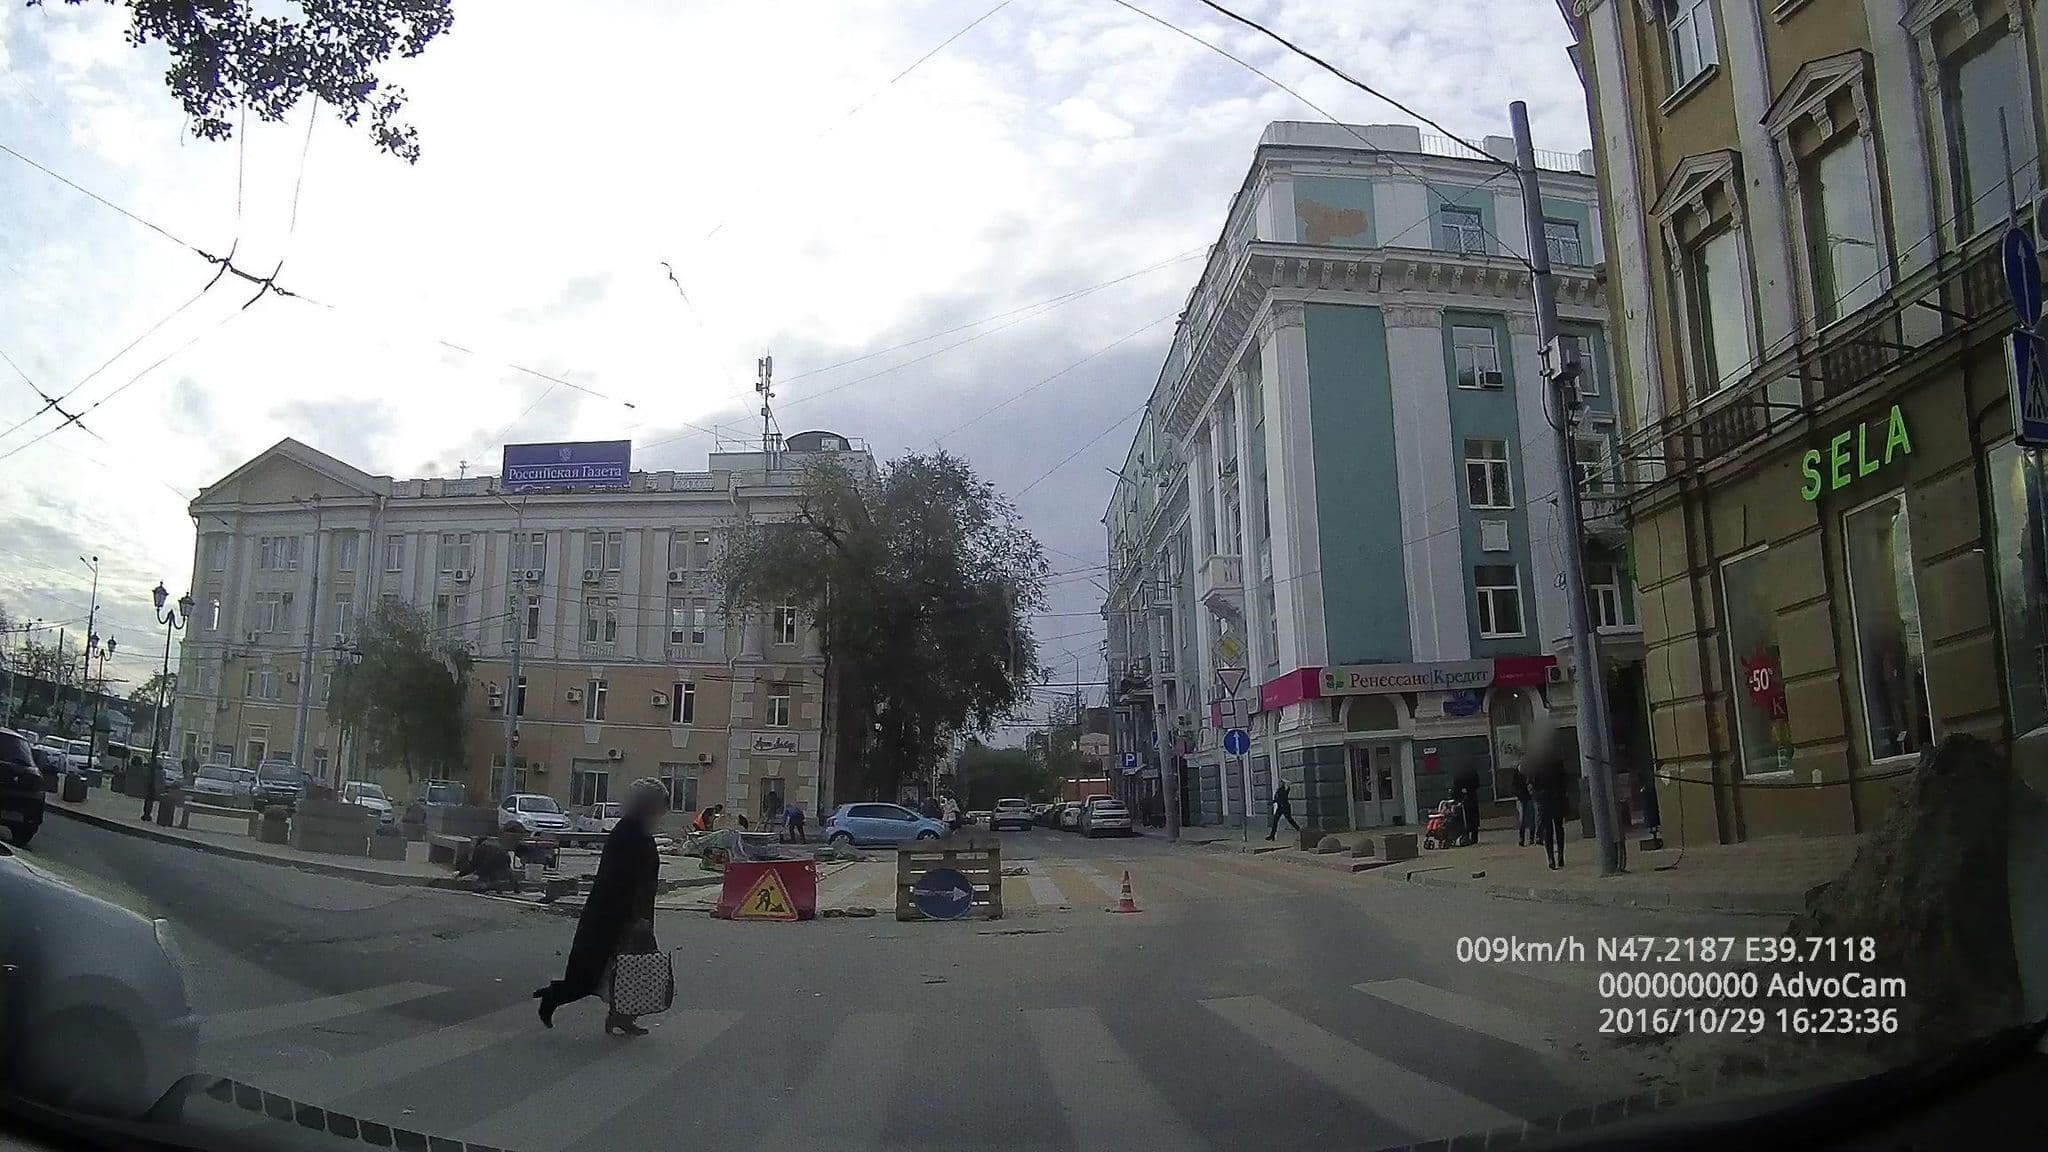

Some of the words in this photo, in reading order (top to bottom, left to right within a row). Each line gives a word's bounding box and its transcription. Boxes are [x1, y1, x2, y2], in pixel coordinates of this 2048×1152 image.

[1801, 404, 1911, 501] SELA
[508, 467, 579, 481] Российская
[581, 465, 622, 478] Газета
[1433, 668, 1489, 688] Кредит
